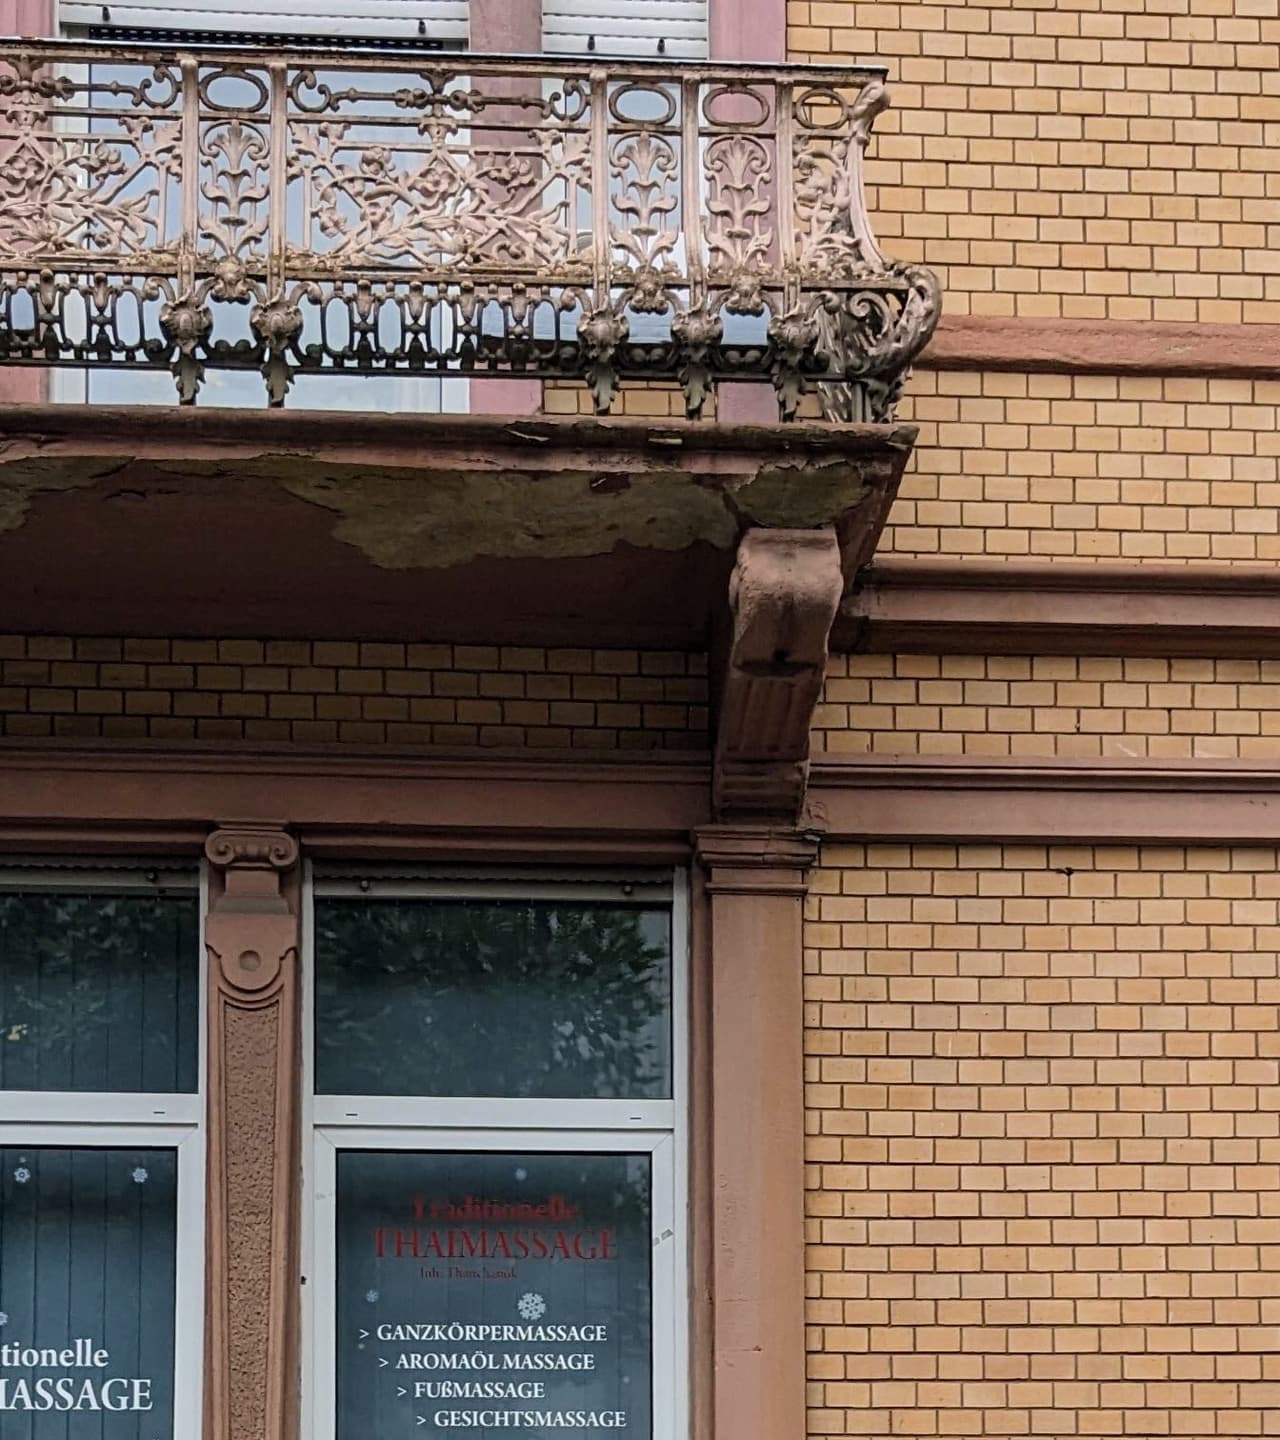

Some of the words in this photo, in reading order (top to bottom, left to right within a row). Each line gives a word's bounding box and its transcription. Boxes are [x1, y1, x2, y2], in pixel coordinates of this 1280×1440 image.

[370, 1227, 618, 1260] THAIMASSAGE
[376, 1322, 608, 1342] GANZKÖRPERMASSAGE
[395, 1350, 499, 1370] AROMAÖL
[503, 1353, 595, 1370] MASSAGE
[414, 1380, 545, 1399] FUßMASSAGE
[434, 1410, 627, 1428] GESICHTSMASSAGE
